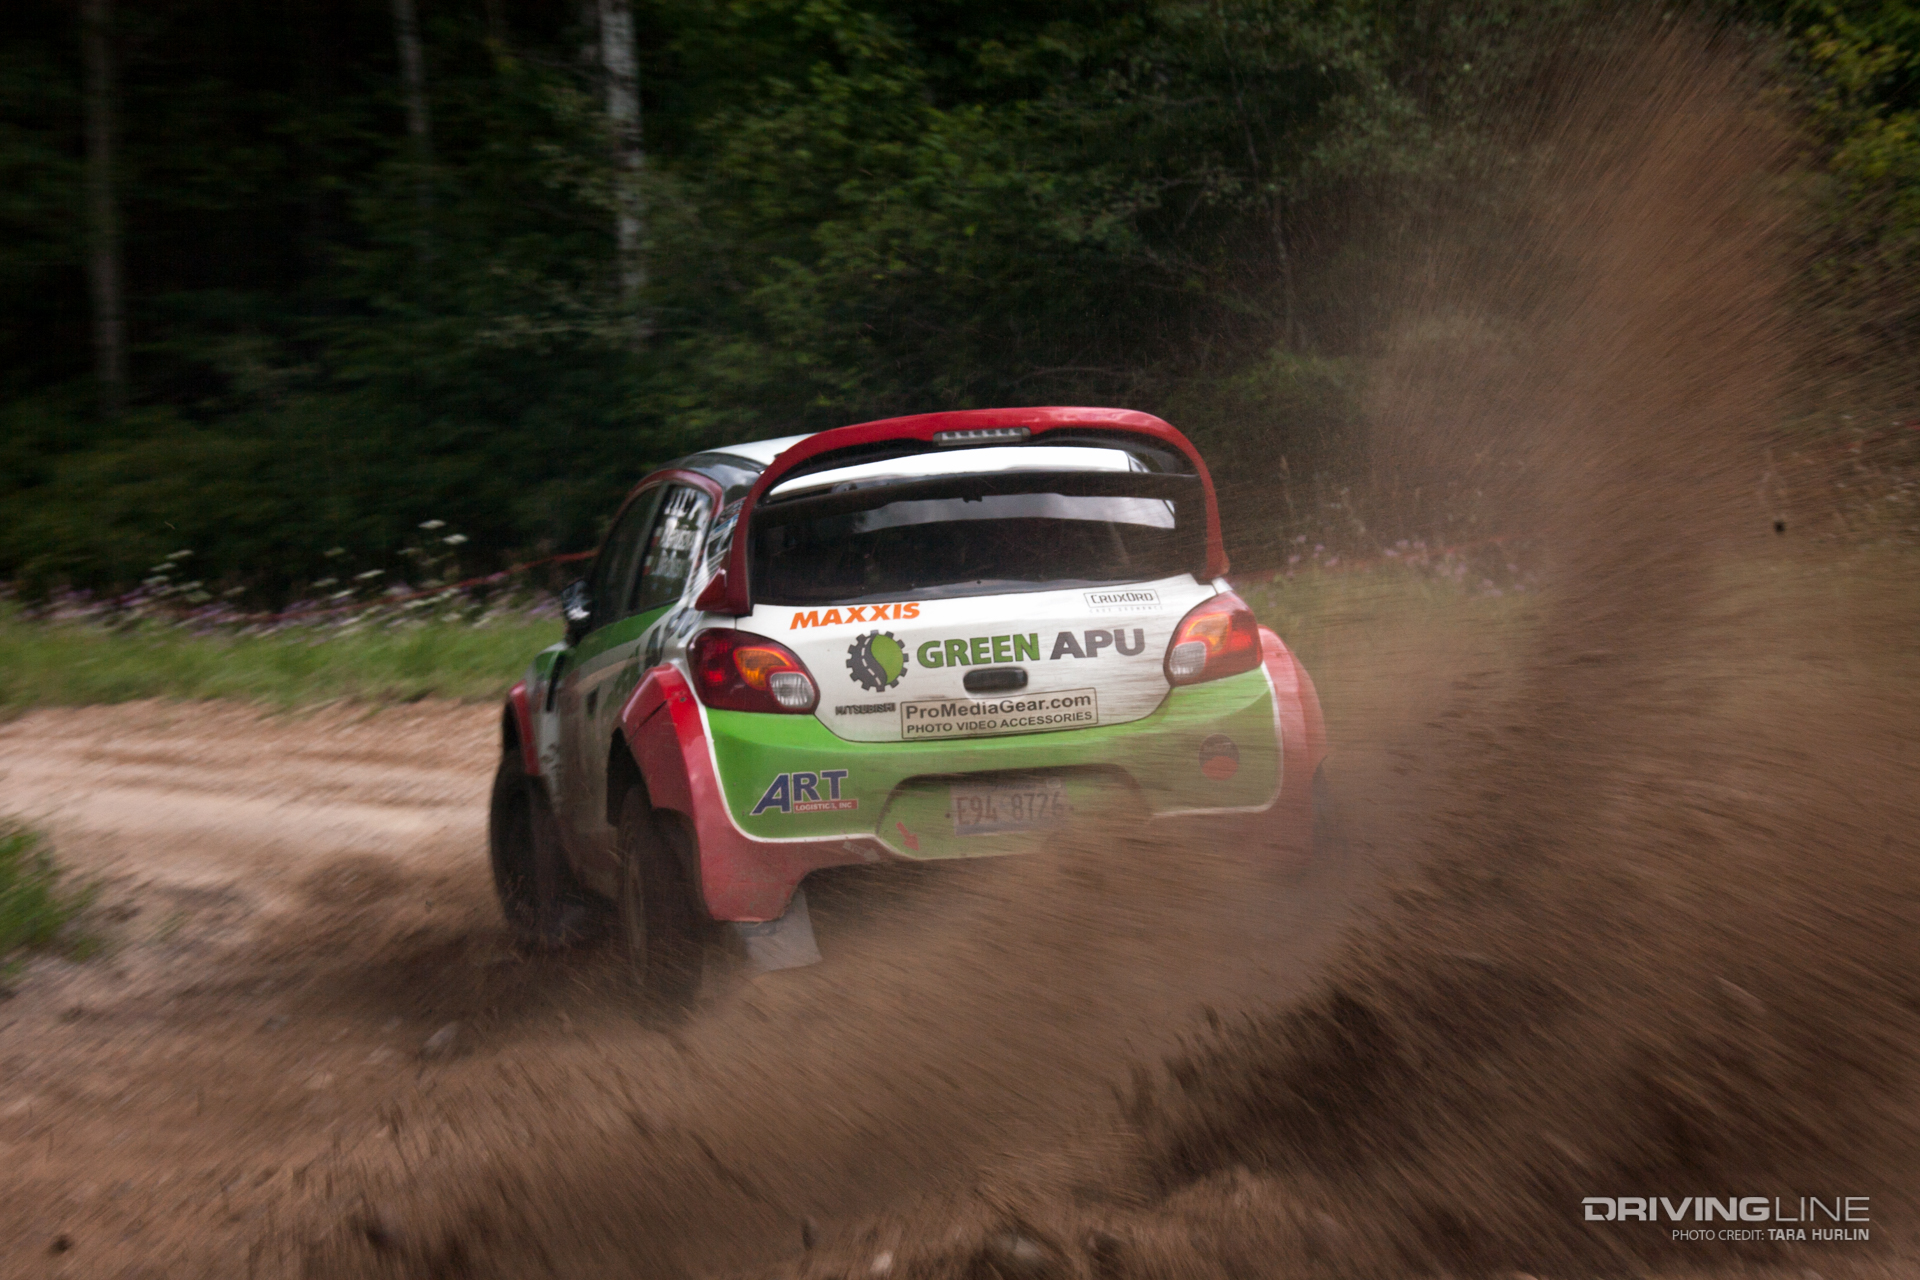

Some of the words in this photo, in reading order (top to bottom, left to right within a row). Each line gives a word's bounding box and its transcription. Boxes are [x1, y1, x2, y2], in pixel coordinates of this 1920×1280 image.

[789, 602, 920, 630] MAXXIS
[916, 632, 1041, 669] GREEN
[1049, 628, 1146, 660] APU
[905, 695, 1092, 719] ProMediaGear.com
[907, 722, 953, 733] PHOTO
[956, 719, 997, 731] VIDEO
[1000, 711, 1092, 728] ACCESSORIES
[749, 768, 849, 816] ART
